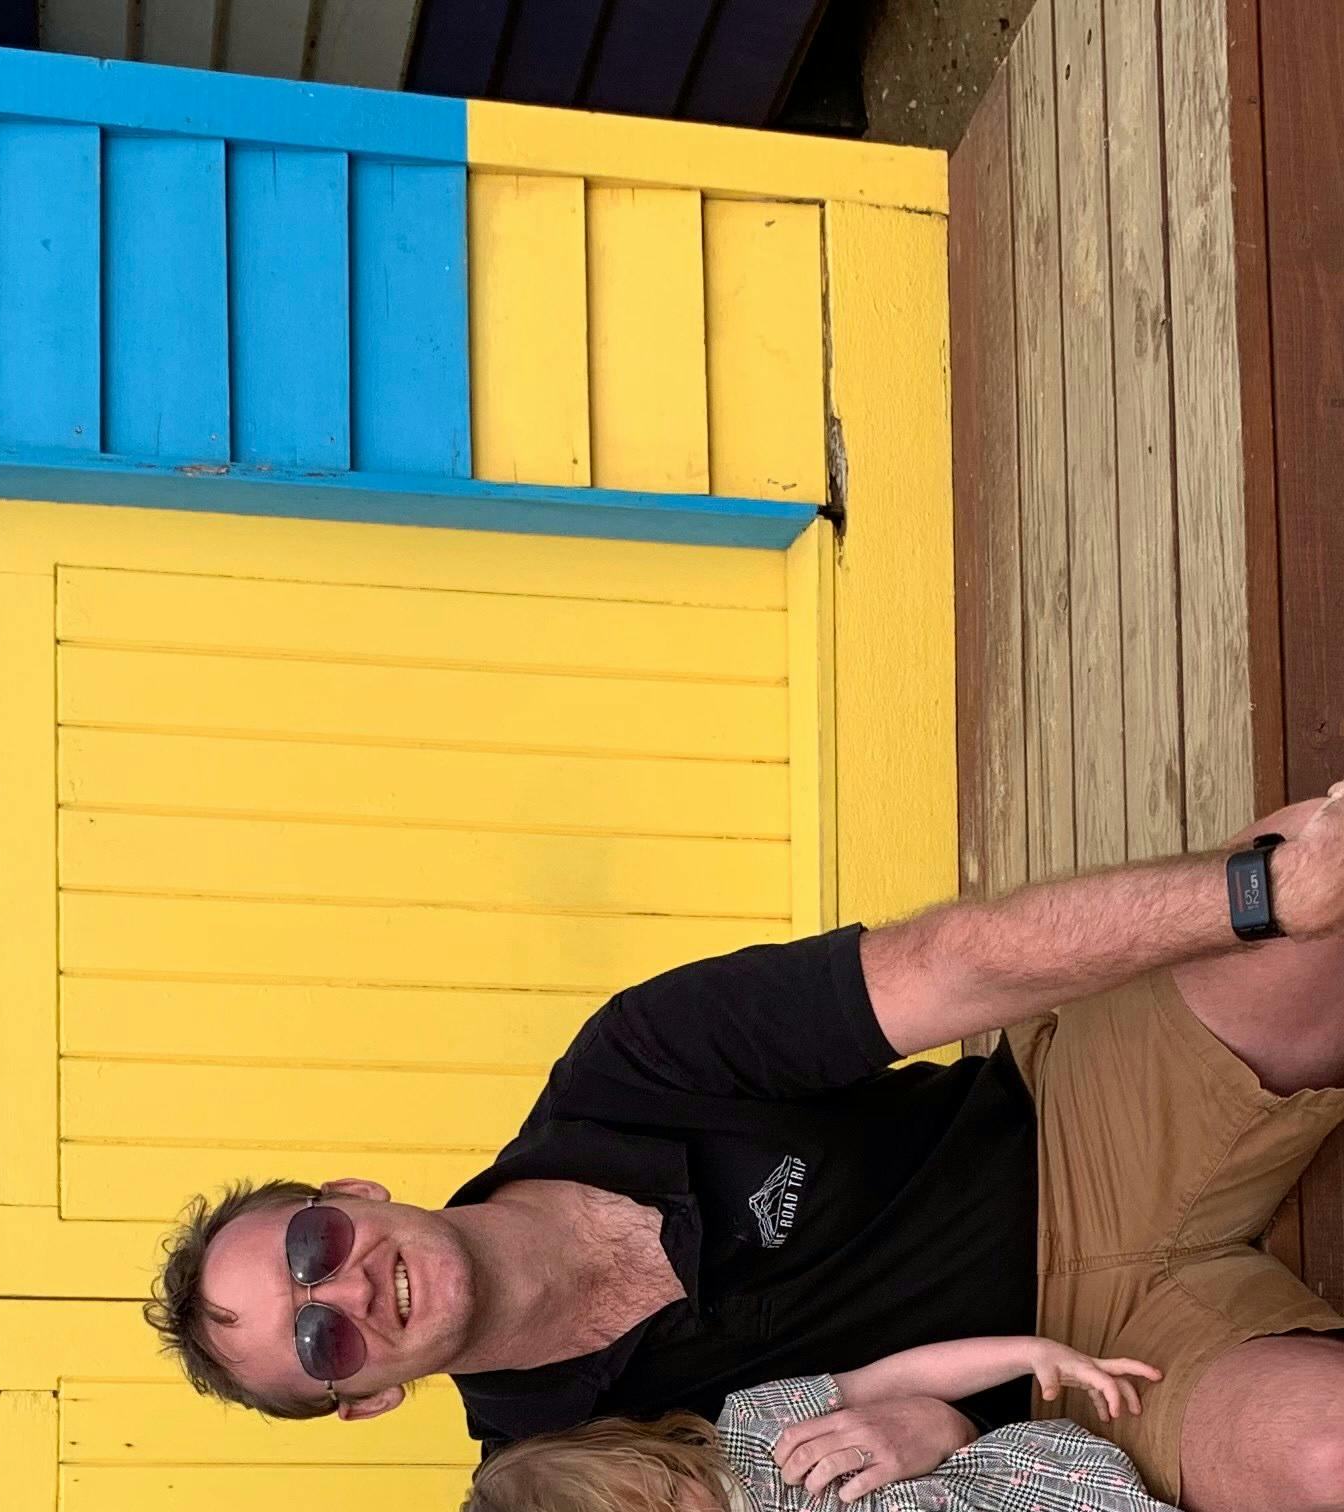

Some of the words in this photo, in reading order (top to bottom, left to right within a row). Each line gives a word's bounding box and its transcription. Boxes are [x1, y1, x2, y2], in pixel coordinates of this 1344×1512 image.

[1250, 874, 1259, 889] 5
[1244, 889, 1260, 905] 52
[787, 1157, 807, 1187] TRIP
[779, 1192, 799, 1228] ROAD
[767, 1232, 789, 1248] THE
